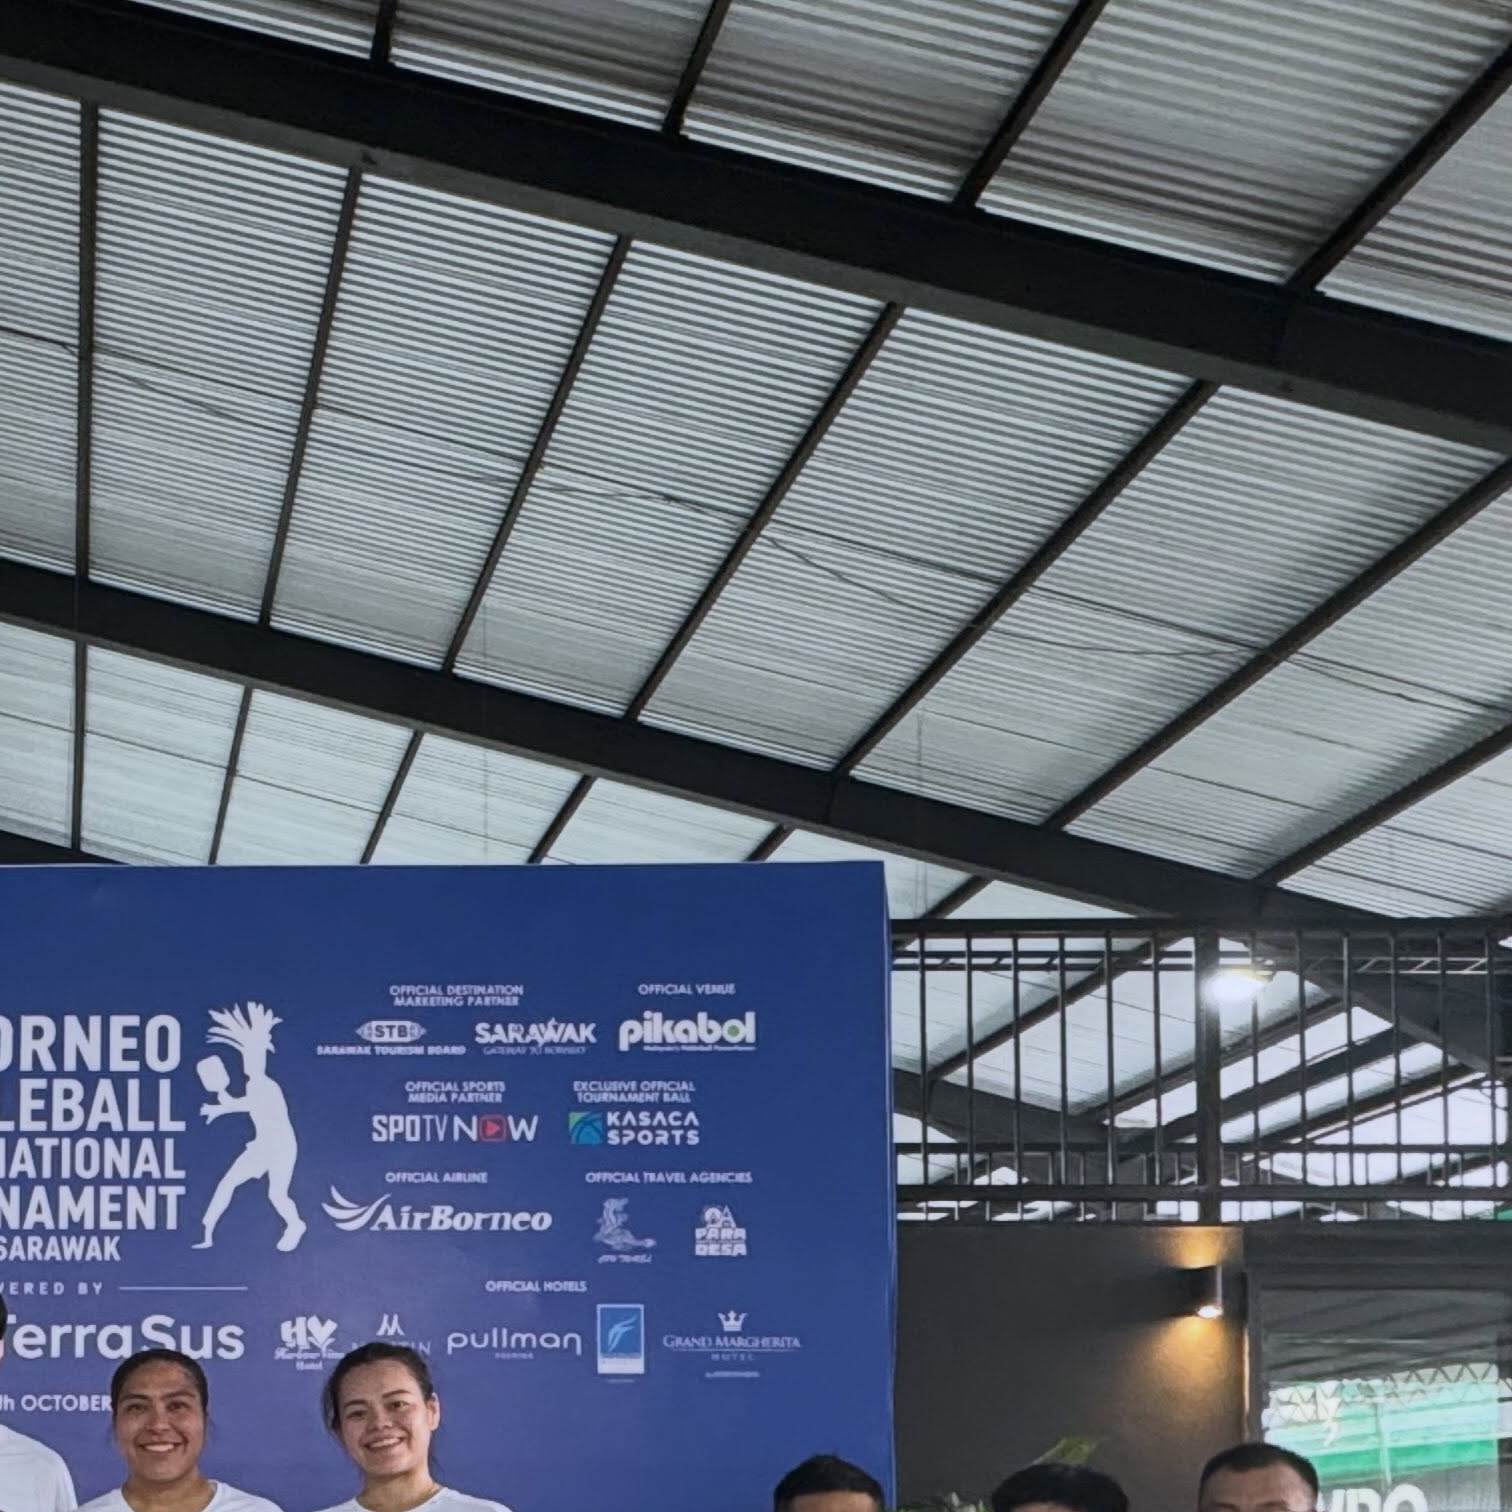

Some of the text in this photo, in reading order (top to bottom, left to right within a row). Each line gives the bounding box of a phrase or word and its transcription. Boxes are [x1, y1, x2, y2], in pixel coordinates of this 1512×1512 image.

[390, 984, 524, 997] OFFICIAL DESTINATION
[637, 983, 693, 996] OFFICIAL
[374, 1023, 409, 1038] STB
[474, 1018, 597, 1047] SARAWAK
[618, 1009, 756, 1052] pikabol
[404, 1081, 506, 1093] OFFICIAL SPORTS
[573, 1080, 696, 1093] EXCLUSIVE OFFICIAL
[407, 1093, 503, 1104] MEDIA PARTNER
[606, 1110, 700, 1127] KASACA
[607, 1129, 700, 1146] SPORTS
[384, 1171, 488, 1183] OFFICIAL AIRLINE
[584, 1171, 753, 1184] OFFICIAL TRAVEL AGENCIES
[368, 1203, 554, 1233] AirBorneo
[77, 1281, 103, 1295] BY
[485, 1280, 587, 1293] OFFICIAL HOTELS
[446, 1327, 582, 1356] pullman
[20, 1394, 113, 1412] OCTOBER
